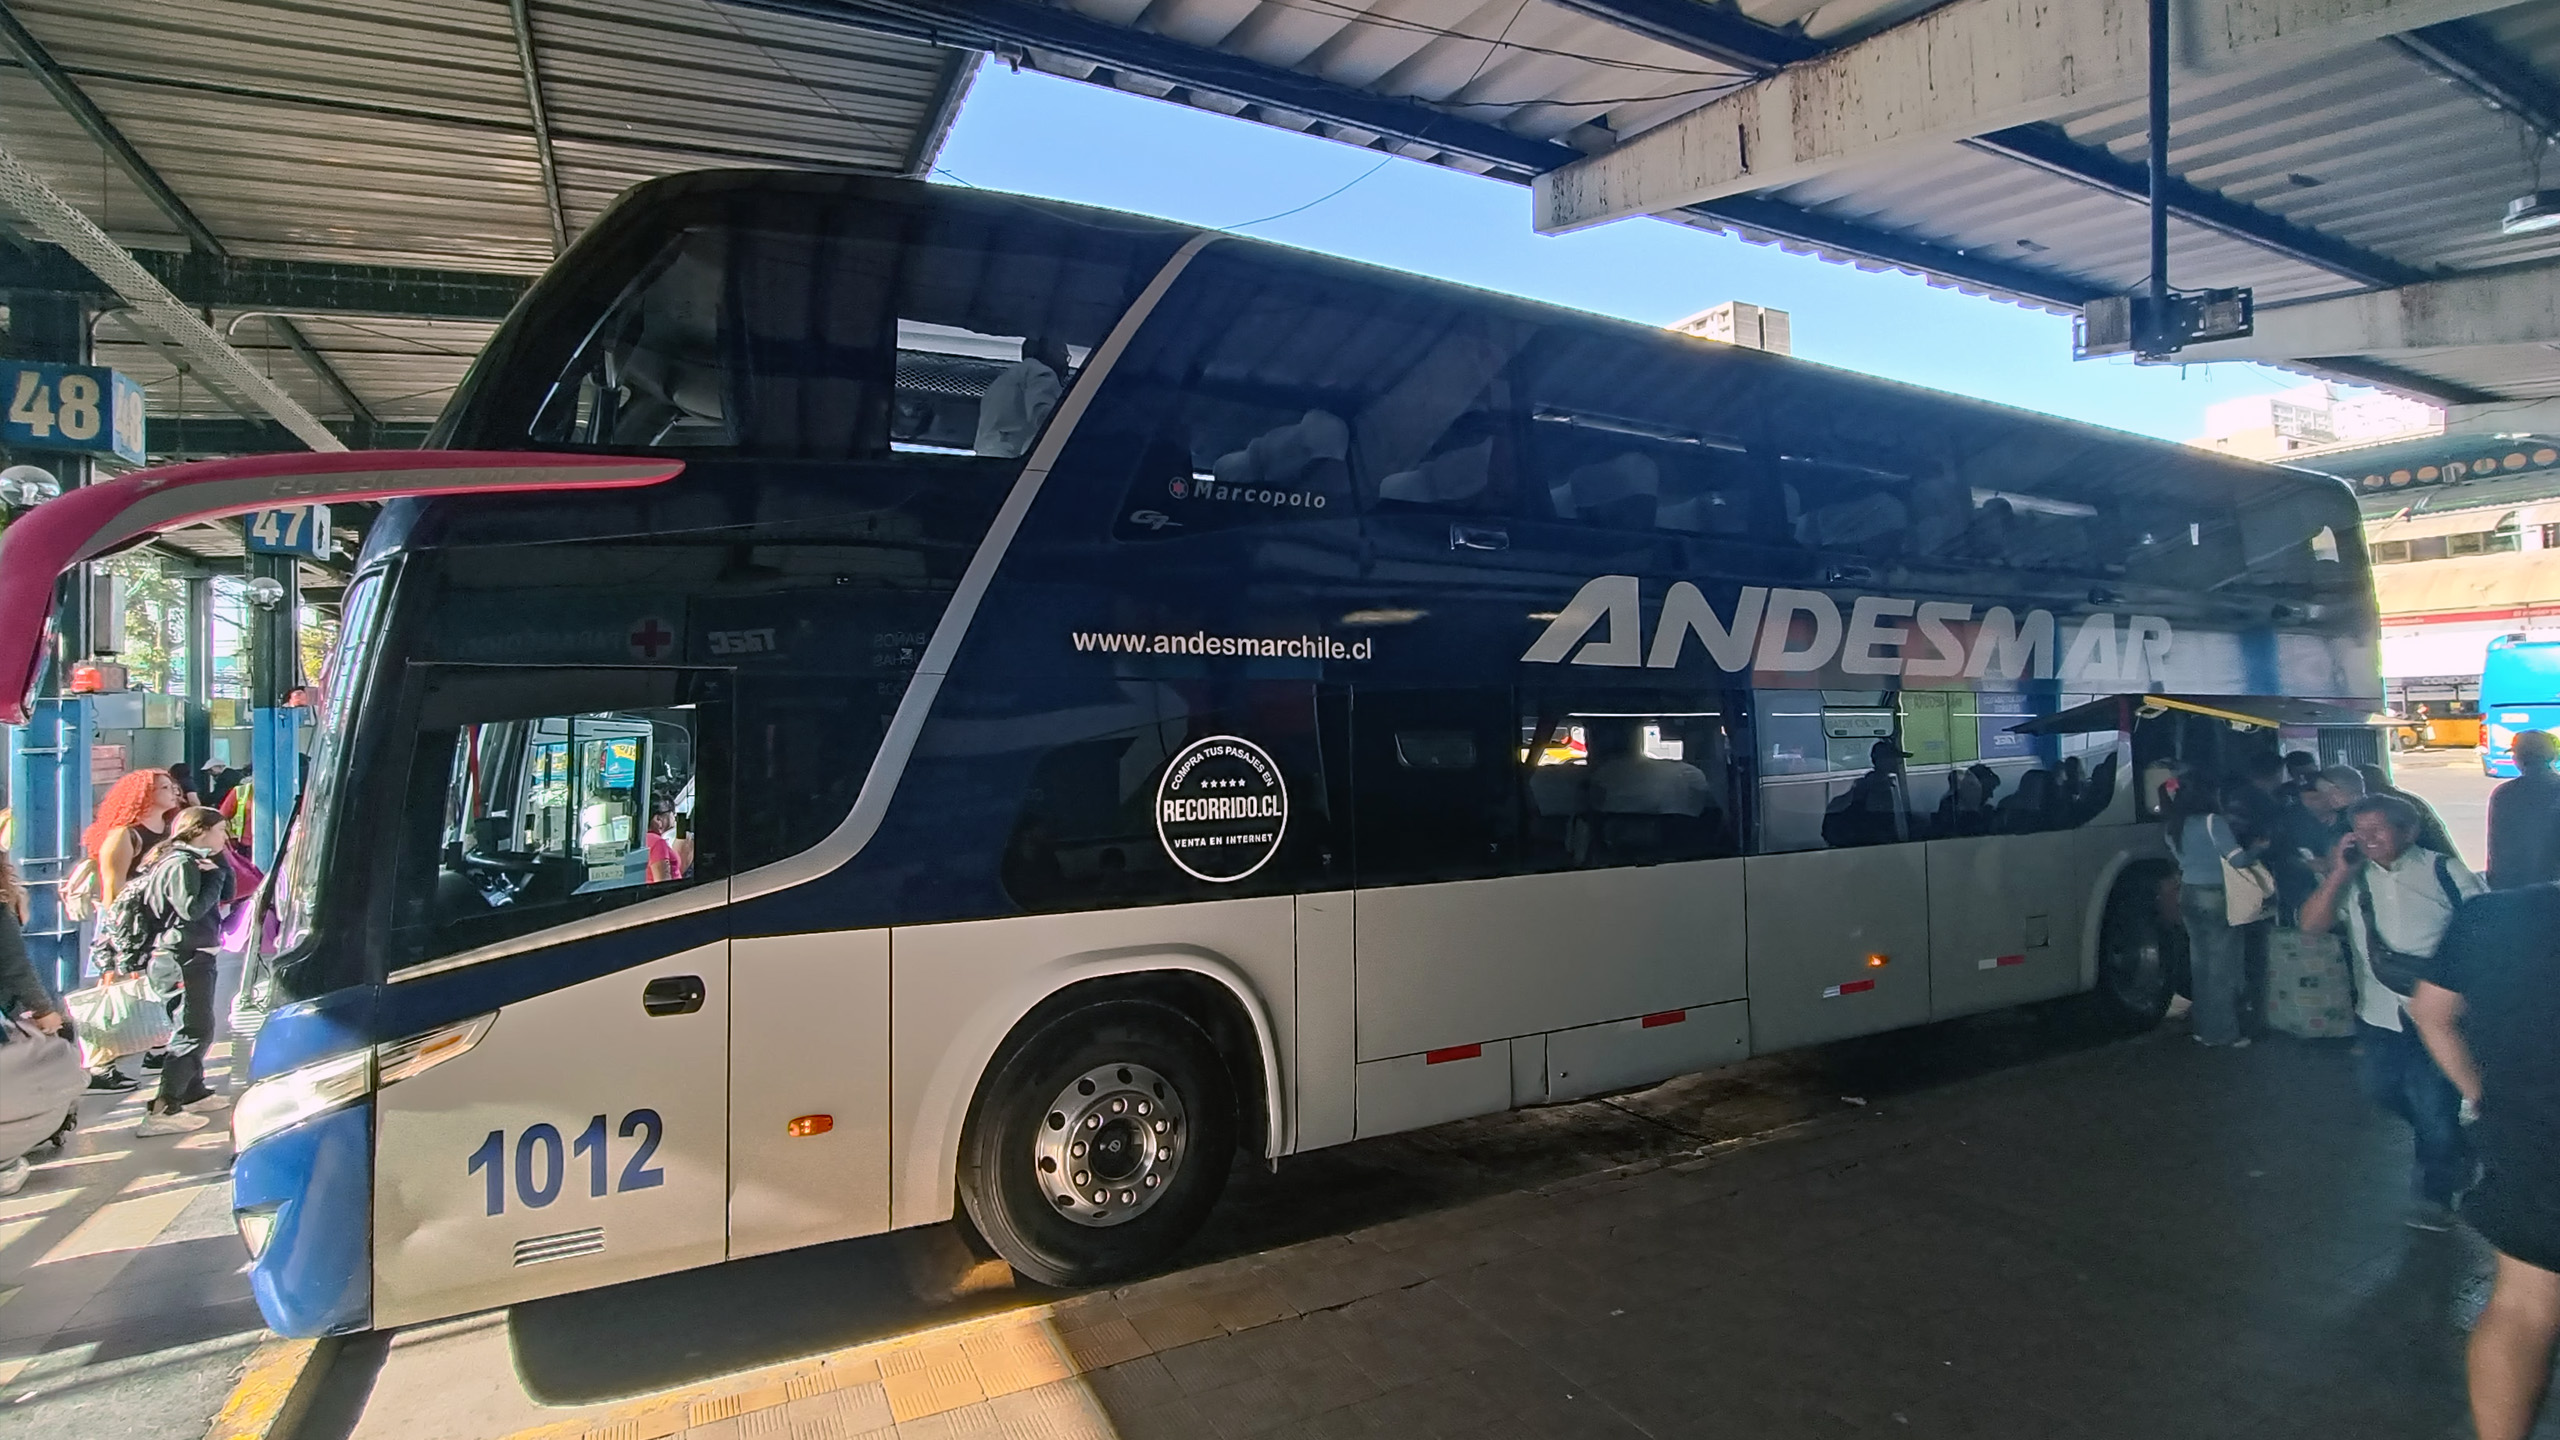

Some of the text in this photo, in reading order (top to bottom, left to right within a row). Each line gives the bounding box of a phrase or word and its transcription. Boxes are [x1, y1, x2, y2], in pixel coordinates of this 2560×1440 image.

[9, 371, 100, 440] 48
[1194, 480, 1326, 509] Marcopolo
[253, 506, 308, 547] 47
[1072, 631, 1371, 660] www.andesmarchile.cl
[1520, 575, 2172, 681] ANDESMAR
[1171, 746, 1274, 791] COMPRA TUS PASAJES EN
[1163, 795, 1282, 823] RECORRIDO.CL
[1174, 833, 1273, 849] VENTA EN INTERNET
[468, 1108, 664, 1217] 1012
